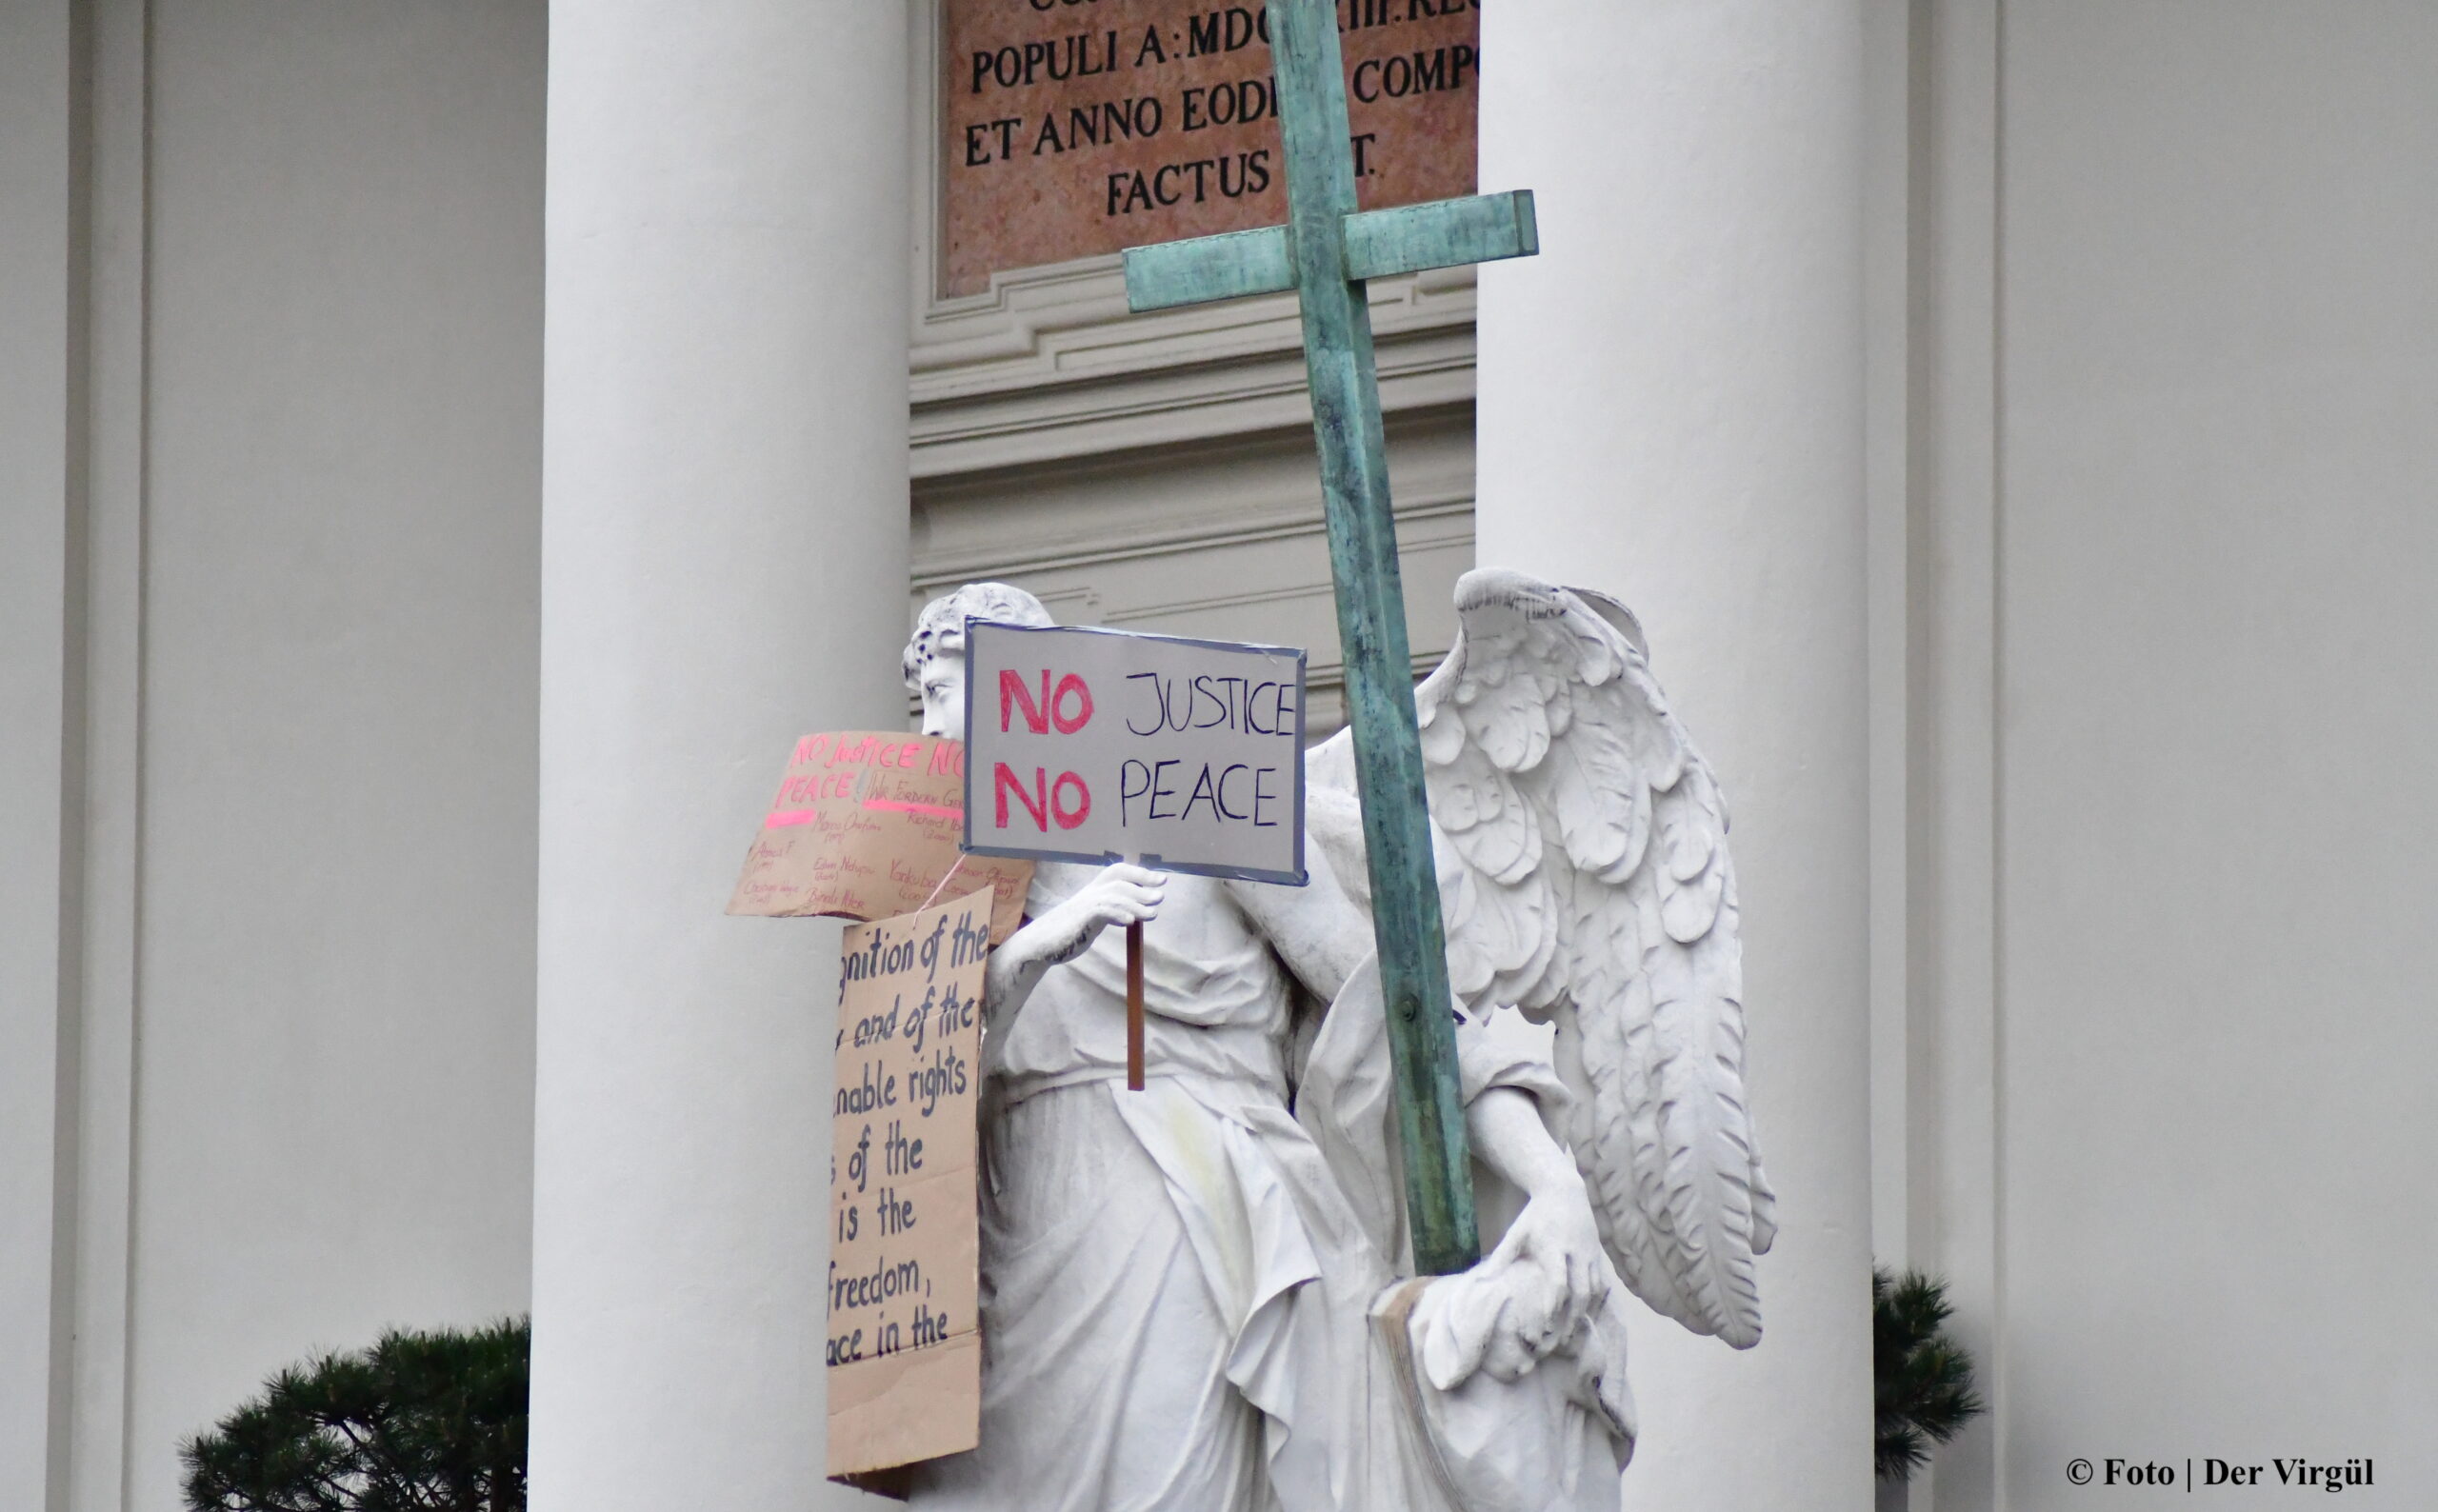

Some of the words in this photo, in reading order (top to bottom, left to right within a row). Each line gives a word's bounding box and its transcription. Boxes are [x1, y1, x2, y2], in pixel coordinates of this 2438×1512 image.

[972, 31, 1117, 92] POPULI
[965, 118, 1021, 167] ET
[1033, 97, 1163, 155] ANNO
[1352, 45, 1479, 104] COMP
[1107, 149, 1270, 217] FACTUS
[1000, 668, 1094, 734] NO
[1126, 672, 1296, 736] JUSTICE
[790, 734, 830, 768] NO
[994, 762, 1091, 832] NO
[1121, 759, 1278, 827] PEACE
[920, 914, 948, 985] of
[950, 910, 989, 968] the
[853, 993, 901, 1049] and
[902, 985, 936, 1054] of
[938, 981, 976, 1039] the
[832, 1060, 897, 1118] nable
[909, 1045, 967, 1118] rights
[849, 1123, 871, 1193] of
[885, 1119, 923, 1176] the
[839, 1191, 858, 1243] is
[877, 1187, 917, 1237] the
[877, 1310, 900, 1358] in
[911, 1303, 949, 1351] the
